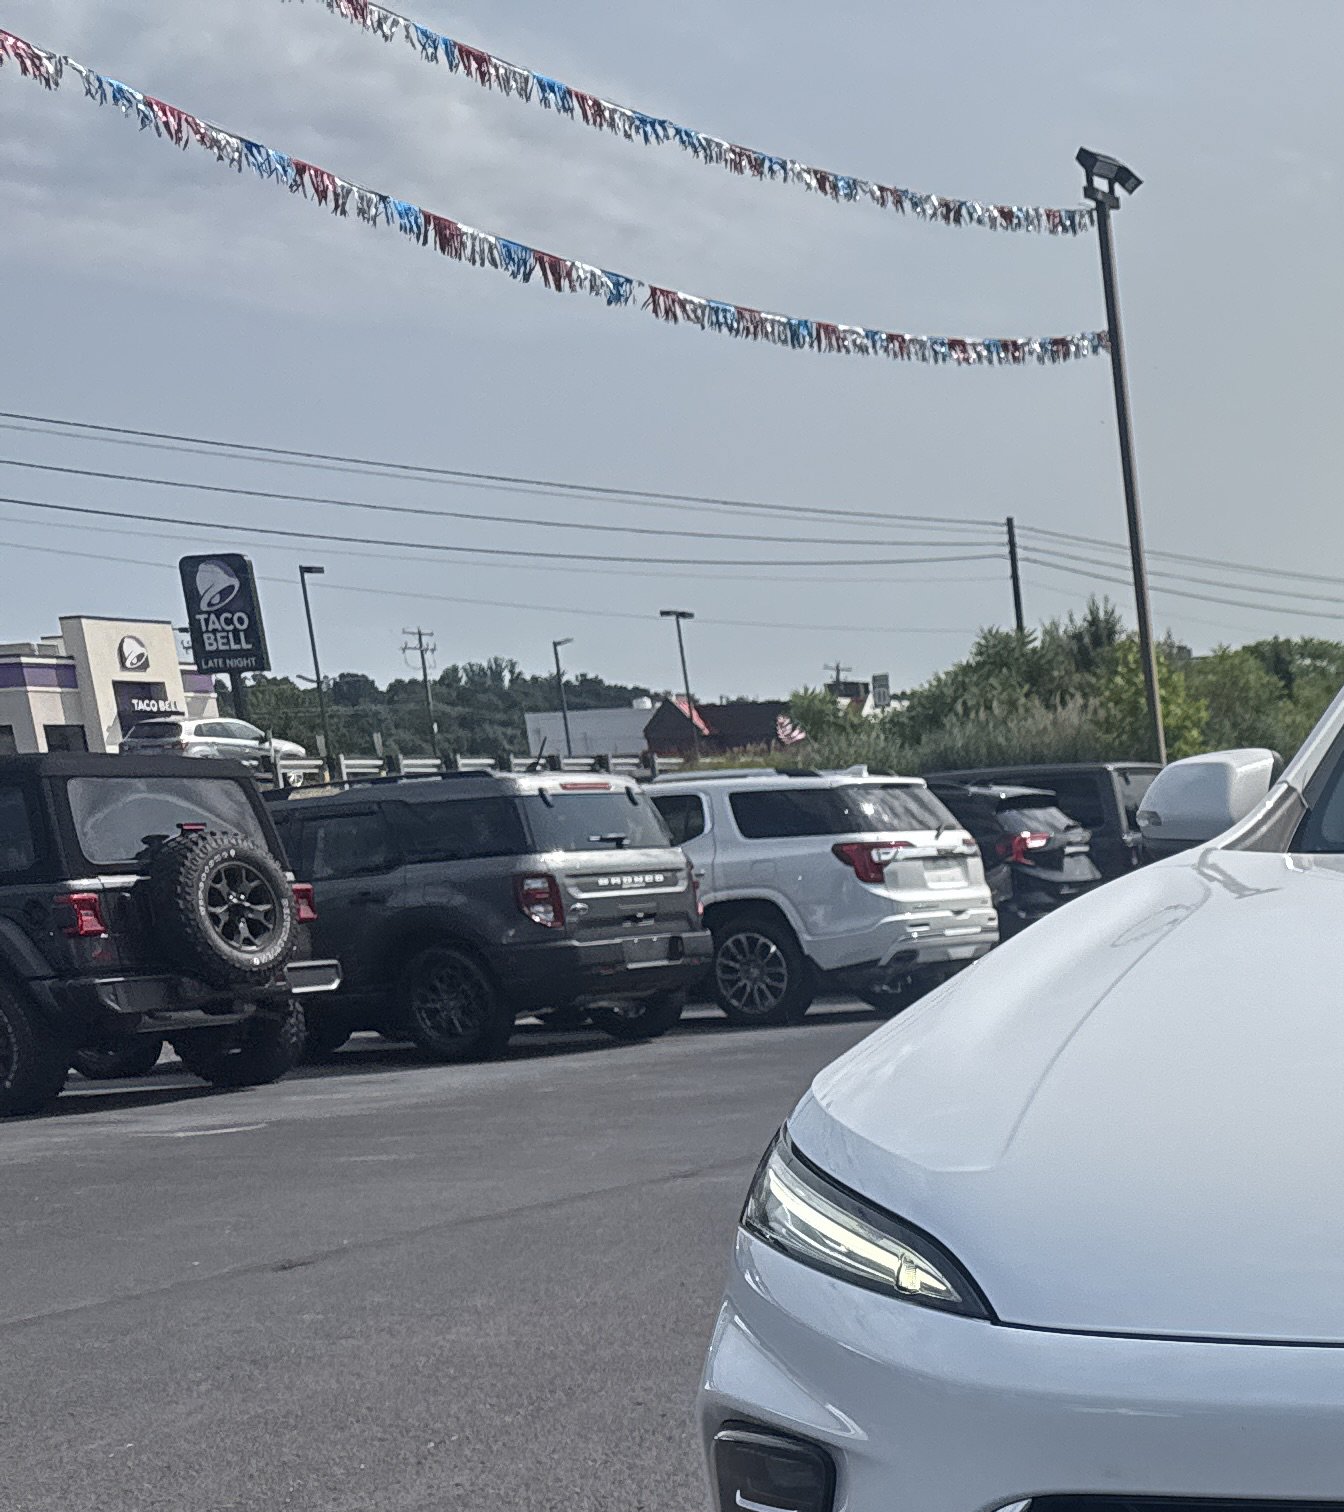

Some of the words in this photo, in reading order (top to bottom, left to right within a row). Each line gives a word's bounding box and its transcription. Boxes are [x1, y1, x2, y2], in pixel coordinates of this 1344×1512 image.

[195, 611, 249, 632] TACO
[202, 631, 253, 651] BELL
[201, 657, 224, 670] LATE
[225, 657, 257, 669] NIGHT
[131, 698, 158, 712] TACO
[158, 699, 181, 712] BELL
